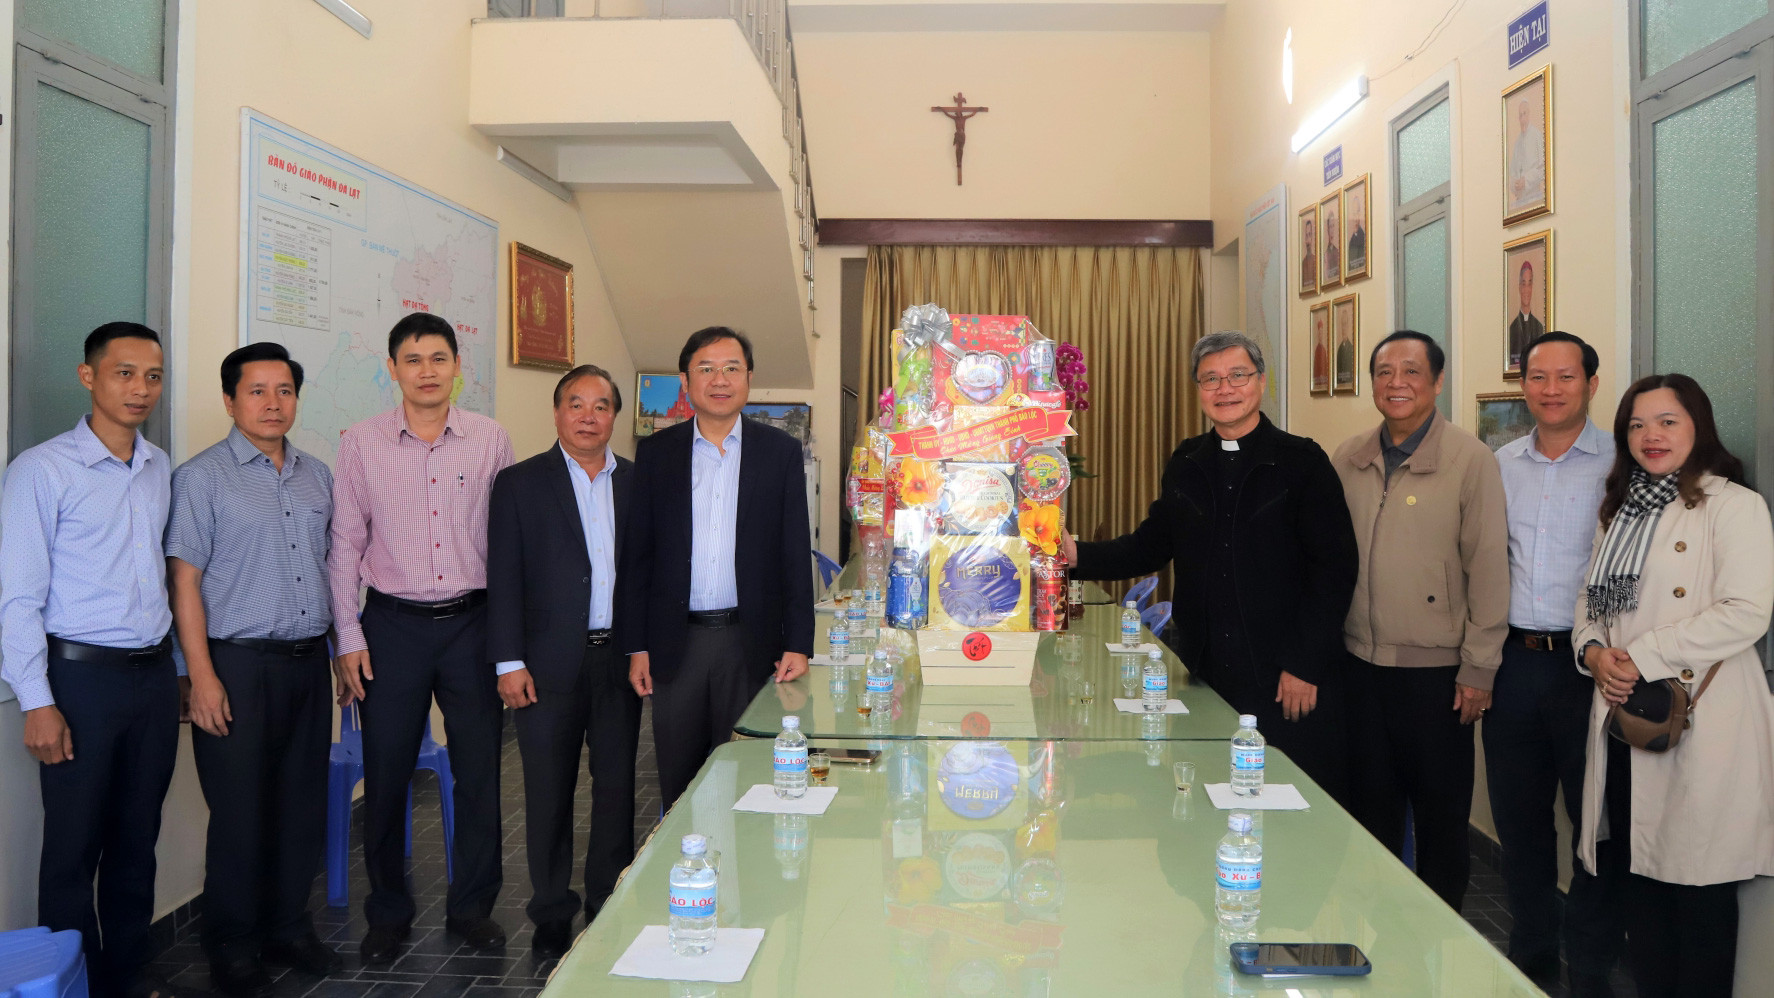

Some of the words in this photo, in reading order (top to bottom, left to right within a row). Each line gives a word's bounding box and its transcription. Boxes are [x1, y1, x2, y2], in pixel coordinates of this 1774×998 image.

[1510, 24, 1529, 55] HIỆN
[1531, 14, 1546, 42] TẠI
[268, 153, 285, 170] BẢN
[286, 162, 297, 174] ĐỒ
[299, 168, 317, 182] GIÁO
[318, 174, 337, 190] PHẬN
[349, 187, 360, 199] LẠT
[956, 565, 1001, 580] MERRY
[1039, 568, 1066, 580] ASTOR
